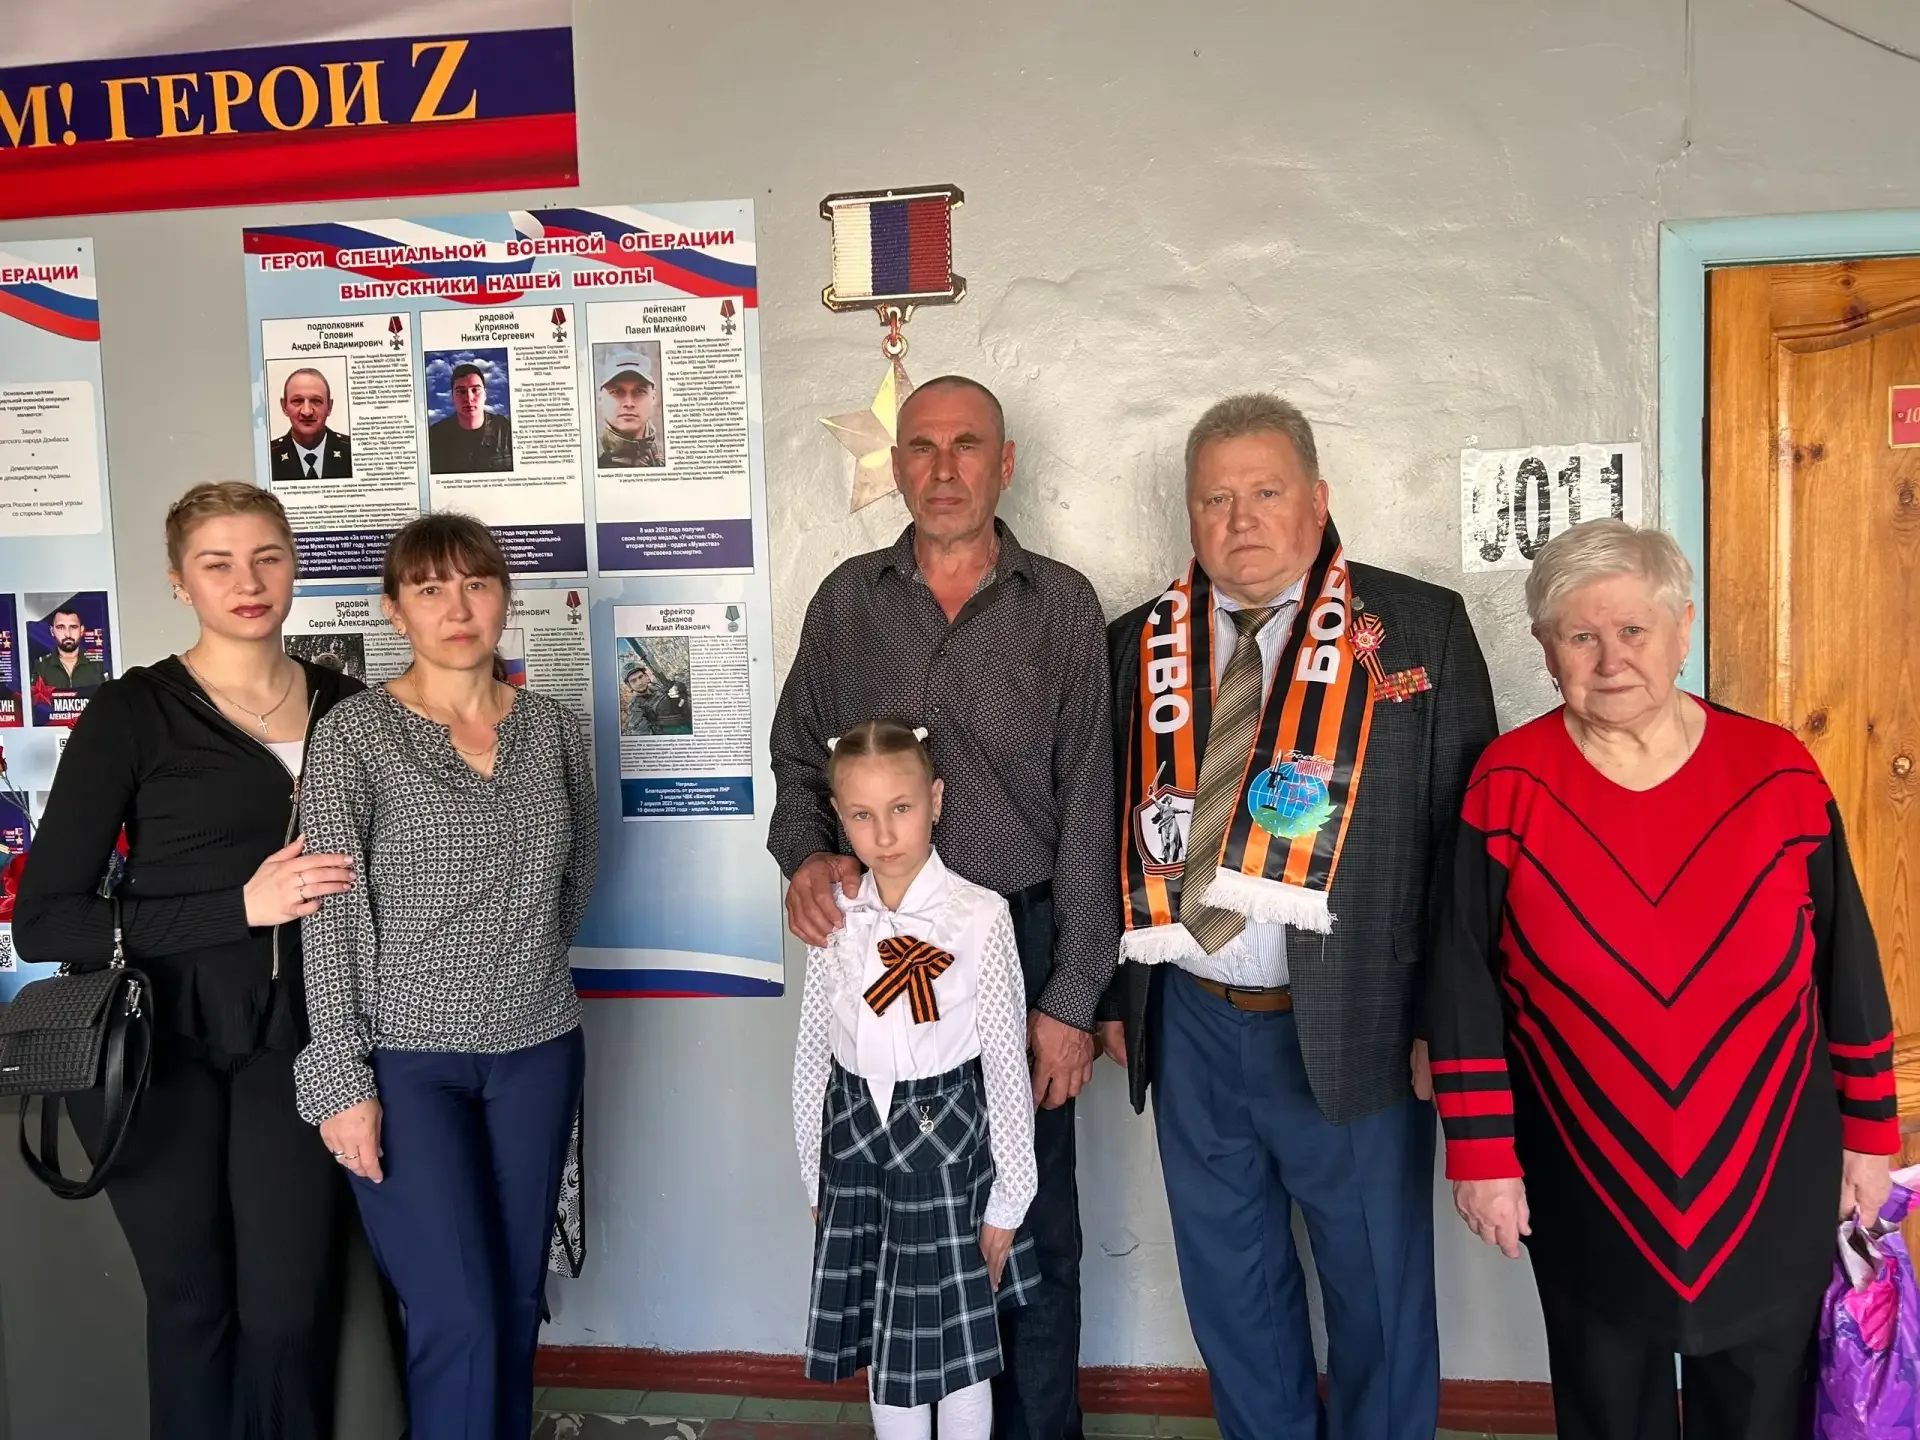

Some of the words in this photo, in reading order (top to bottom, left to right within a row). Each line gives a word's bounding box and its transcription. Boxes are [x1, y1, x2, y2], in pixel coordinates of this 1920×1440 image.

[101, 60, 388, 142] ГЕРОИ
[410, 39, 477, 123] Z
[261, 254, 323, 270] ГЕРОИ
[338, 241, 486, 267] СПЕЦИАЛЬНОЙ
[507, 233, 604, 256] ВОЕННОЙ
[622, 230, 734, 249] ОПЕРАЦИИ
[0, 265, 79, 283] ЕРАЦИИ
[341, 278, 475, 299] ВЫПУСКНИКИ
[488, 271, 560, 291] НАШЕЙ
[574, 269, 652, 287] ШКОЛЫ
[643, 304, 686, 314] лейтенант
[479, 312, 514, 323] рядовой
[643, 314, 687, 324] Коваленко
[307, 320, 364, 331] подполковник
[475, 322, 519, 333] Куприянов
[625, 325, 652, 335] Павел
[654, 324, 706, 334] Михайлович
[319, 331, 353, 340] Головин
[461, 332, 490, 342] Никита
[492, 332, 534, 342] Сергеевич
[292, 341, 321, 352] Андрей
[324, 339, 383, 350] Владимирович
[336, 599, 369, 609] рядовой
[337, 609, 370, 619] Зубарев
[660, 608, 695, 616] ефрейтор
[309, 618, 336, 629] Сергей
[338, 618, 392, 628] Александров
